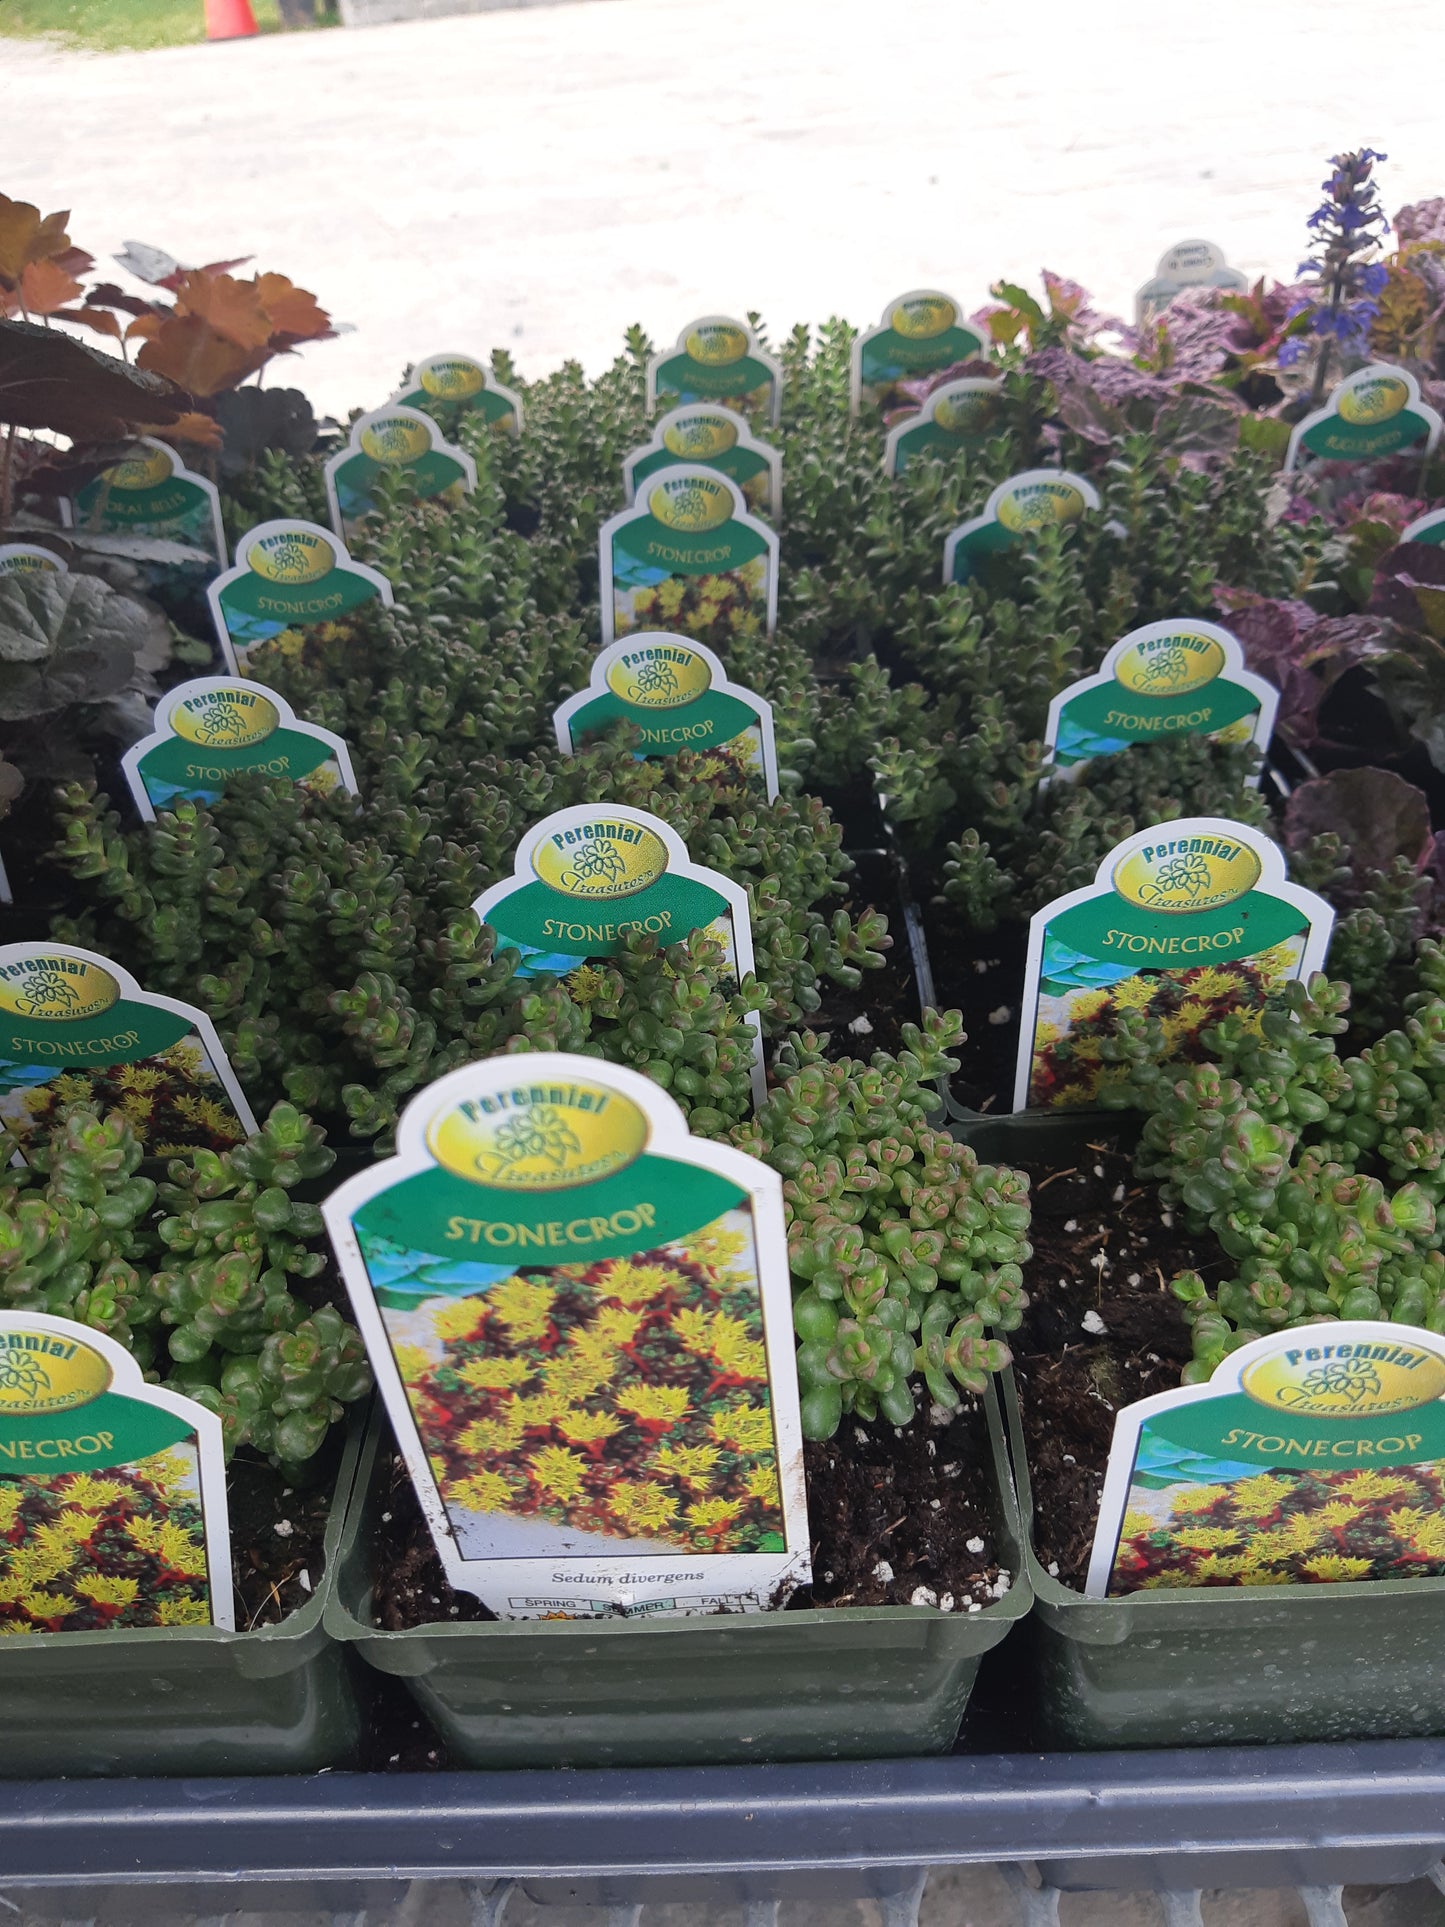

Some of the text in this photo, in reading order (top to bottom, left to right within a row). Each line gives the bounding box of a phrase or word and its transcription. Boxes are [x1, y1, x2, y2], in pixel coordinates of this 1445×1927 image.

[663, 478, 721, 496] Perennial
[259, 533, 318, 551] Perennial
[649, 542, 732, 564] STONECROP
[258, 593, 343, 614] STONECROP
[621, 647, 693, 669] Perennial
[1136, 636, 1212, 656] Perennial
[183, 691, 257, 713] Perennial
[1103, 707, 1212, 731] STONECROP
[638, 719, 714, 744] ONECROP
[551, 823, 644, 850] Perennial
[1141, 838, 1242, 864] Perennial
[541, 910, 672, 942] STONECROP
[1101, 927, 1245, 954] STONECROP
[0, 958, 88, 982] Perennial
[11, 1030, 141, 1056] STONECROP
[459, 1083, 609, 1124] Perennial
[444, 1203, 657, 1248] STONECROP
[1285, 1343, 1429, 1370] Perennial
[1221, 1428, 1422, 1457] STONECROP
[551, 1570, 705, 1586] Sedum divergens
[524, 1598, 577, 1608] SPRING
[701, 1595, 733, 1606] FALL
